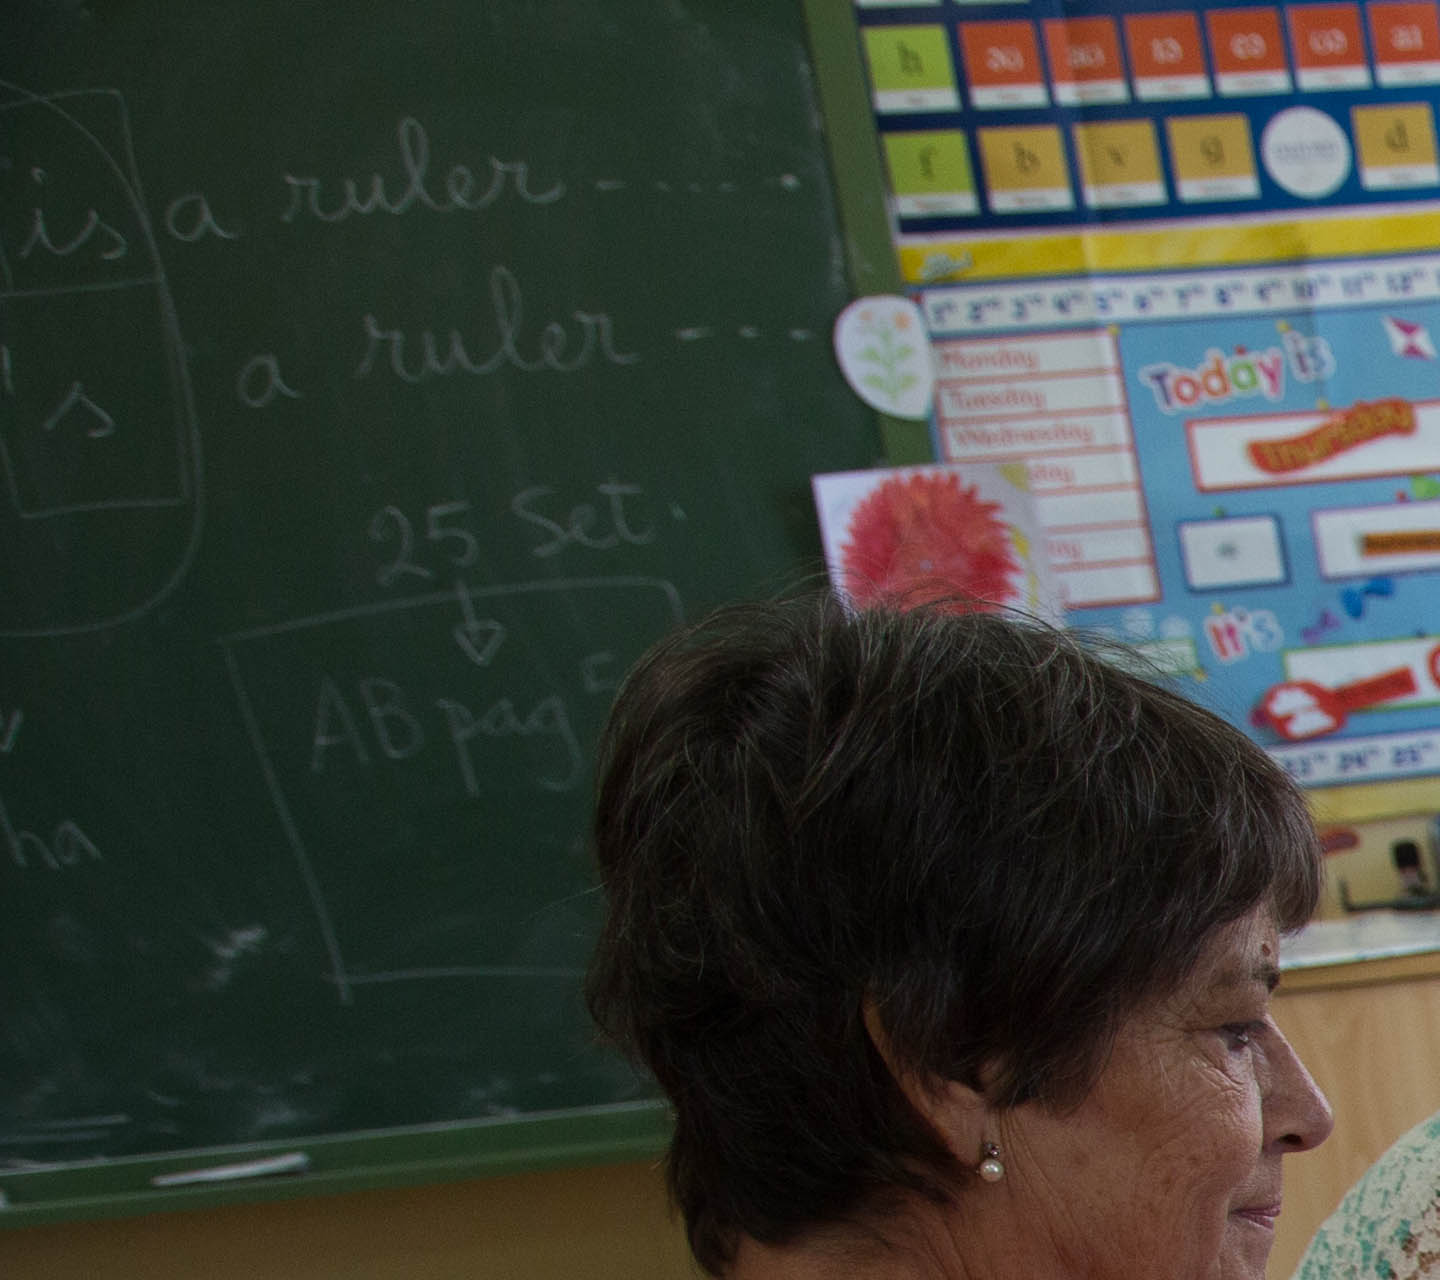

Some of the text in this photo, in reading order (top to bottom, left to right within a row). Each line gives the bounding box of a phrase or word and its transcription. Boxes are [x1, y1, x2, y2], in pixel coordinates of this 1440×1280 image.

[165, 195, 240, 242] a
[281, 116, 567, 224] ruler
[237, 353, 300, 408] a
[353, 265, 641, 386] ruler
[1149, 350, 1282, 408] Today
[368, 502, 480, 588] 25
